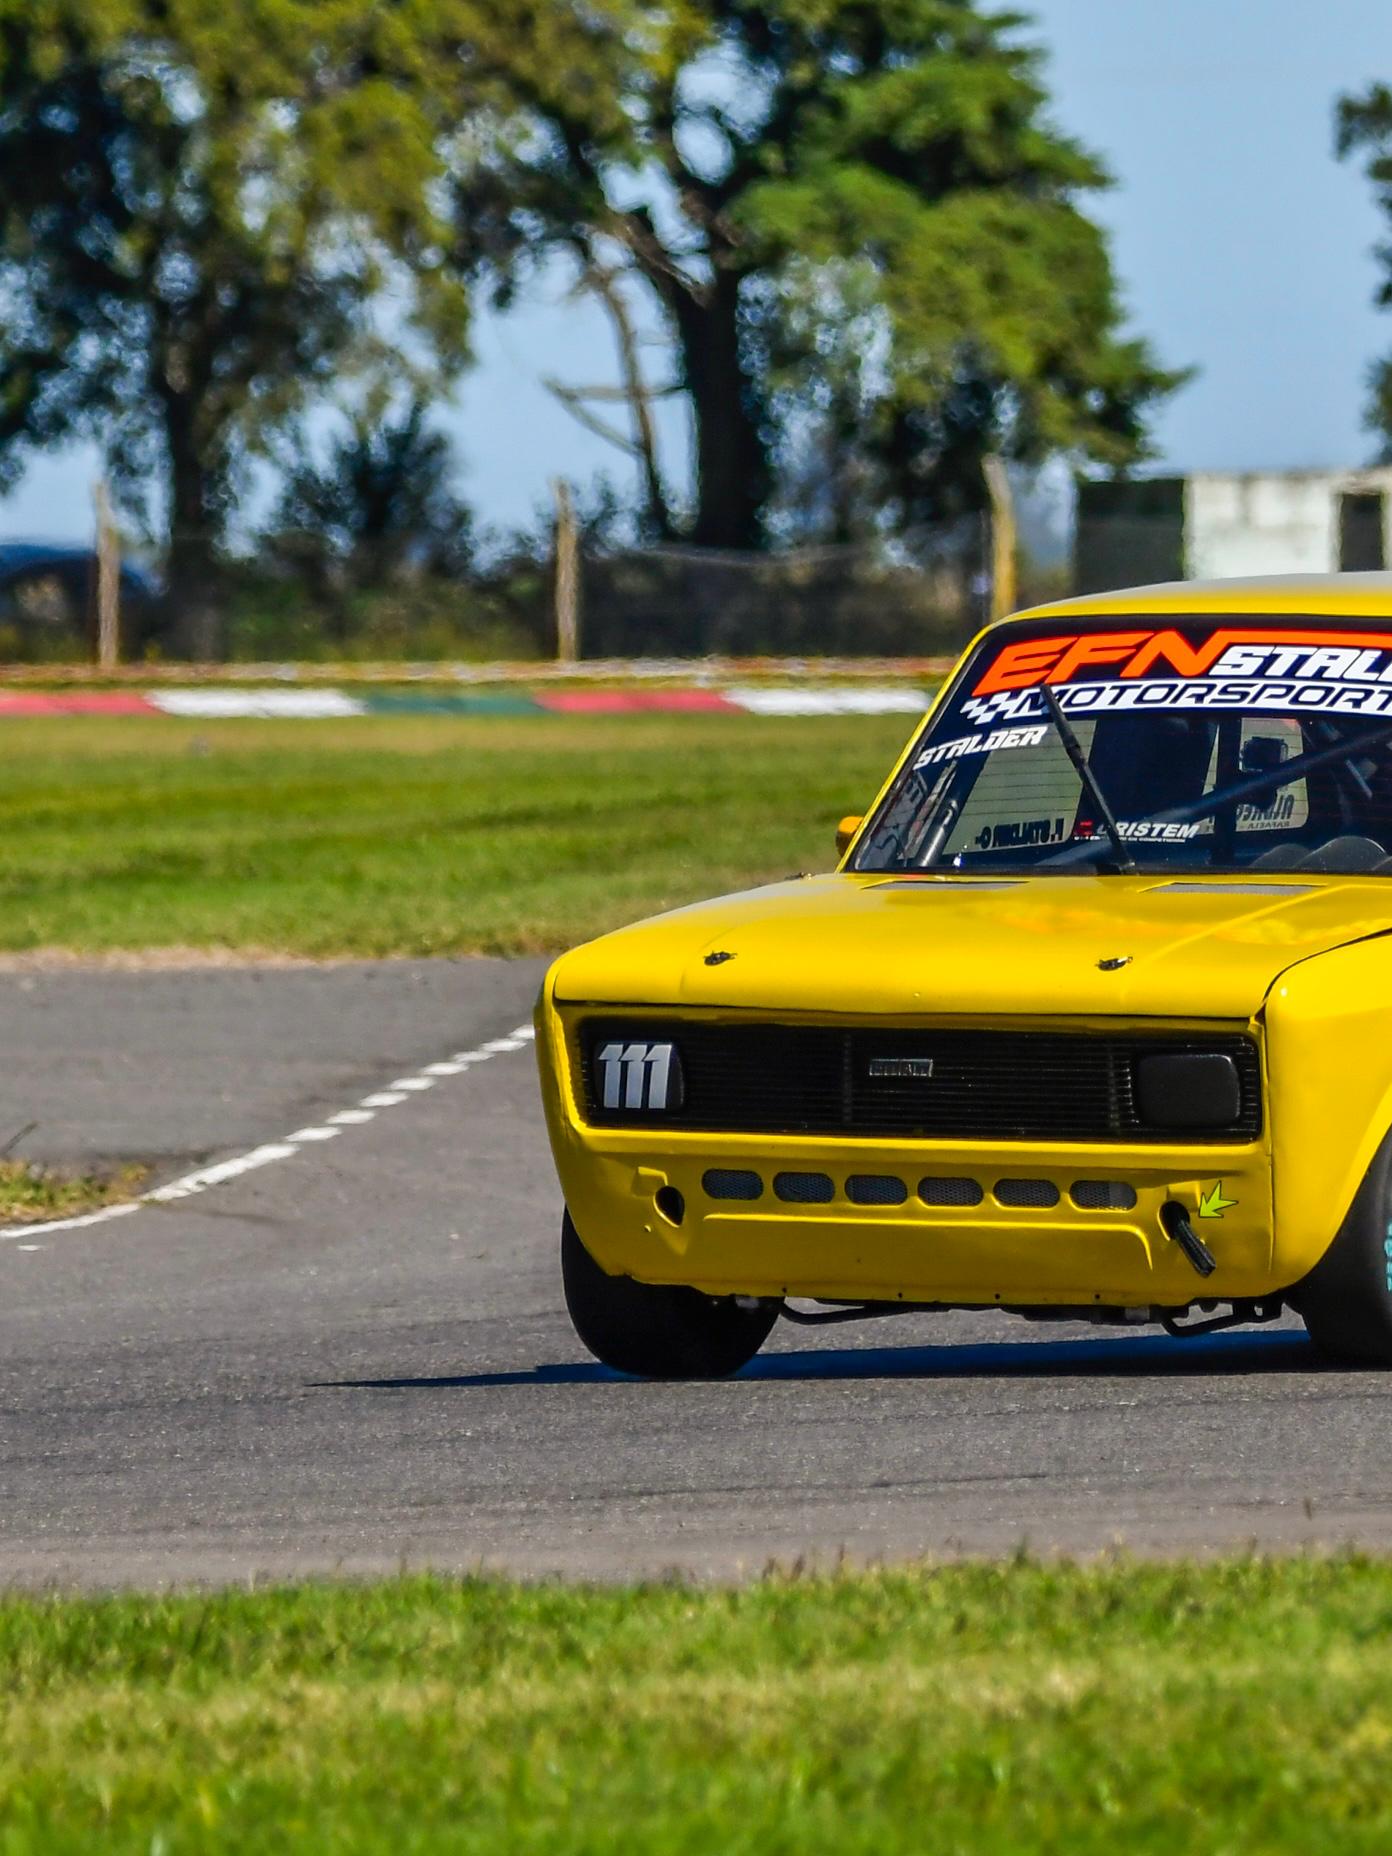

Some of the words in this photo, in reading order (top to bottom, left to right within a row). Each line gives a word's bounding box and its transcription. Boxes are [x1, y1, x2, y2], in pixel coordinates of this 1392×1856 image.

[971, 627, 1232, 697] EFN
[912, 725, 1049, 771] STALDER
[598, 1044, 672, 1109] 111
